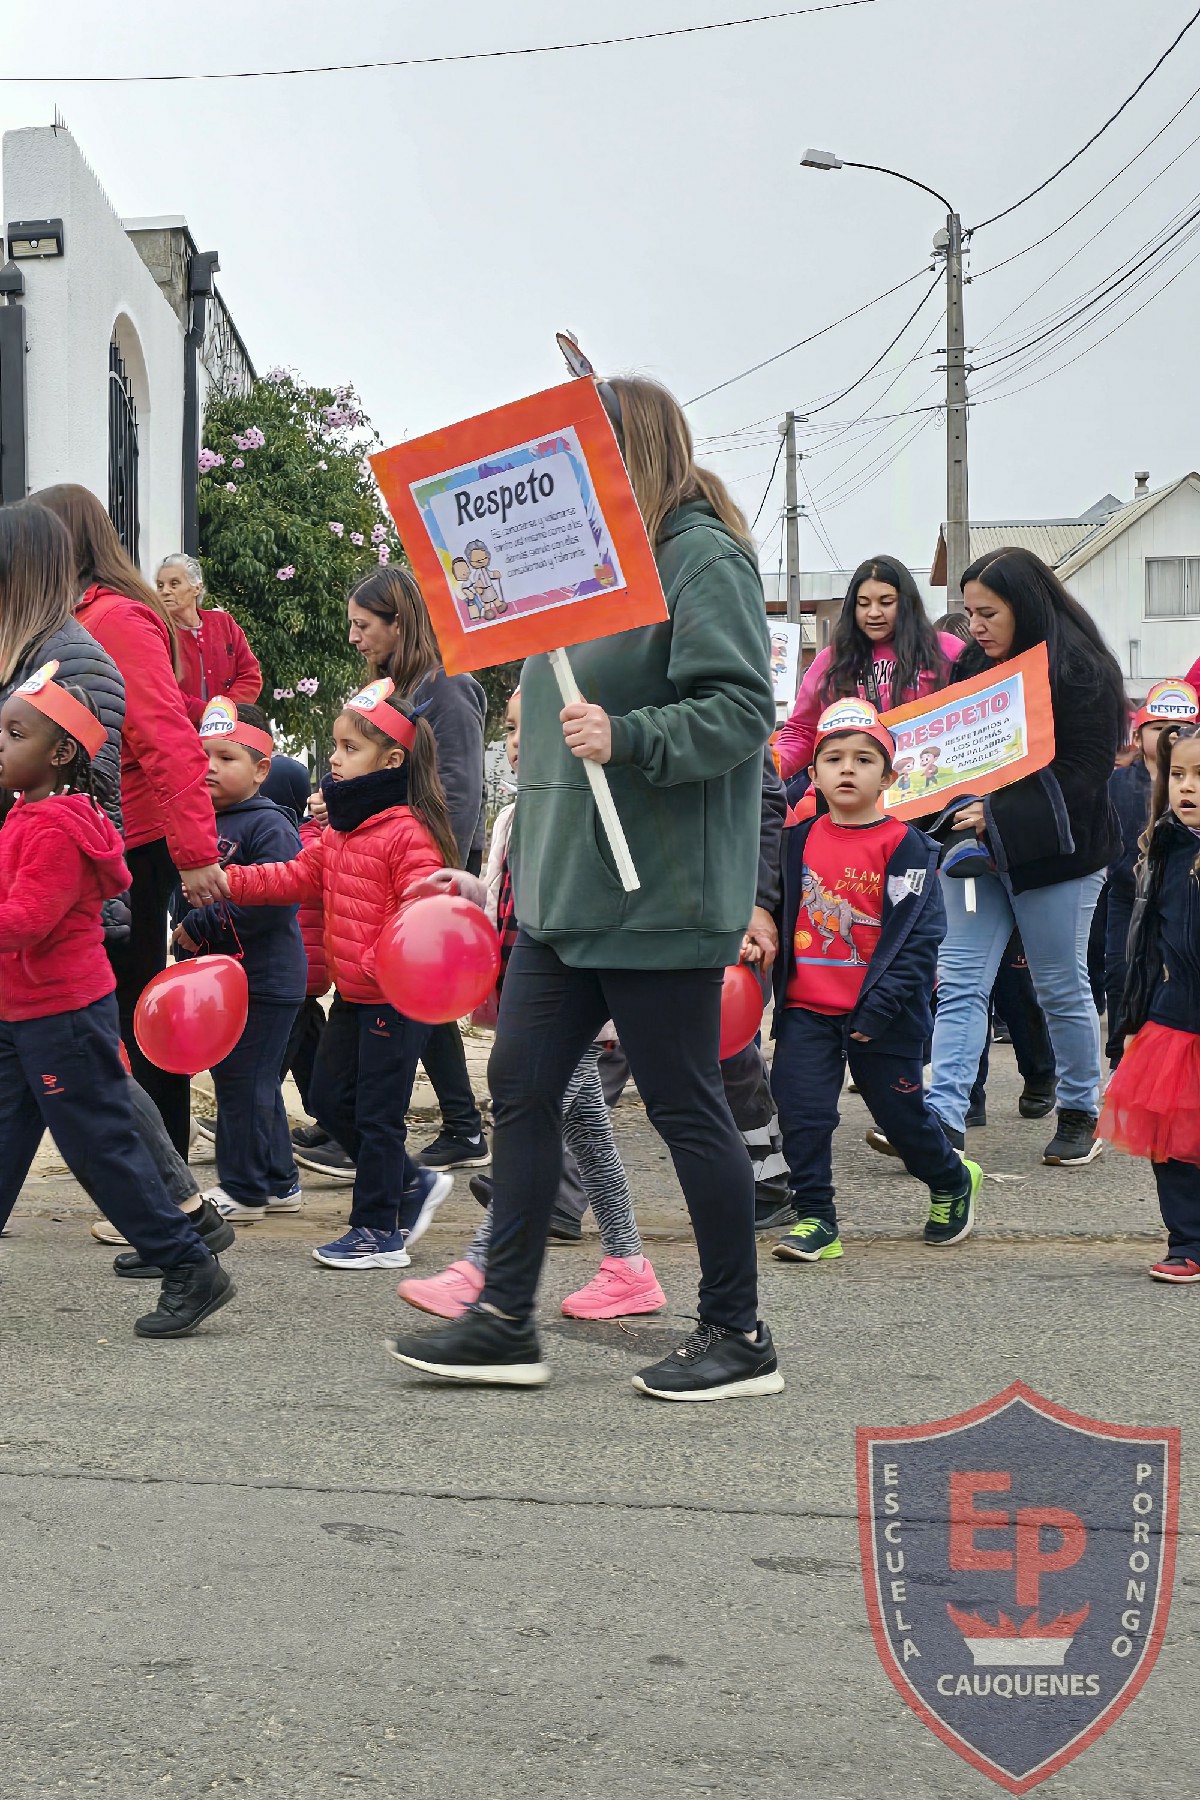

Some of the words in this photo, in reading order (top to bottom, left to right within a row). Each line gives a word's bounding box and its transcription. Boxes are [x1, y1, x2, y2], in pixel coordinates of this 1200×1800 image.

[455, 468, 554, 526] Respeto
[896, 691, 1011, 751] RESPETO
[1150, 704, 1196, 715] RESPETO
[945, 722, 1002, 746] RESPETAMOS
[1003, 717, 1010, 725] A
[946, 752, 964, 763] CON
[967, 734, 1011, 755] PALABRAS
[953, 742, 970, 752] LOS
[844, 867, 880, 883] SLAM
[834, 879, 882, 897] DUNK
